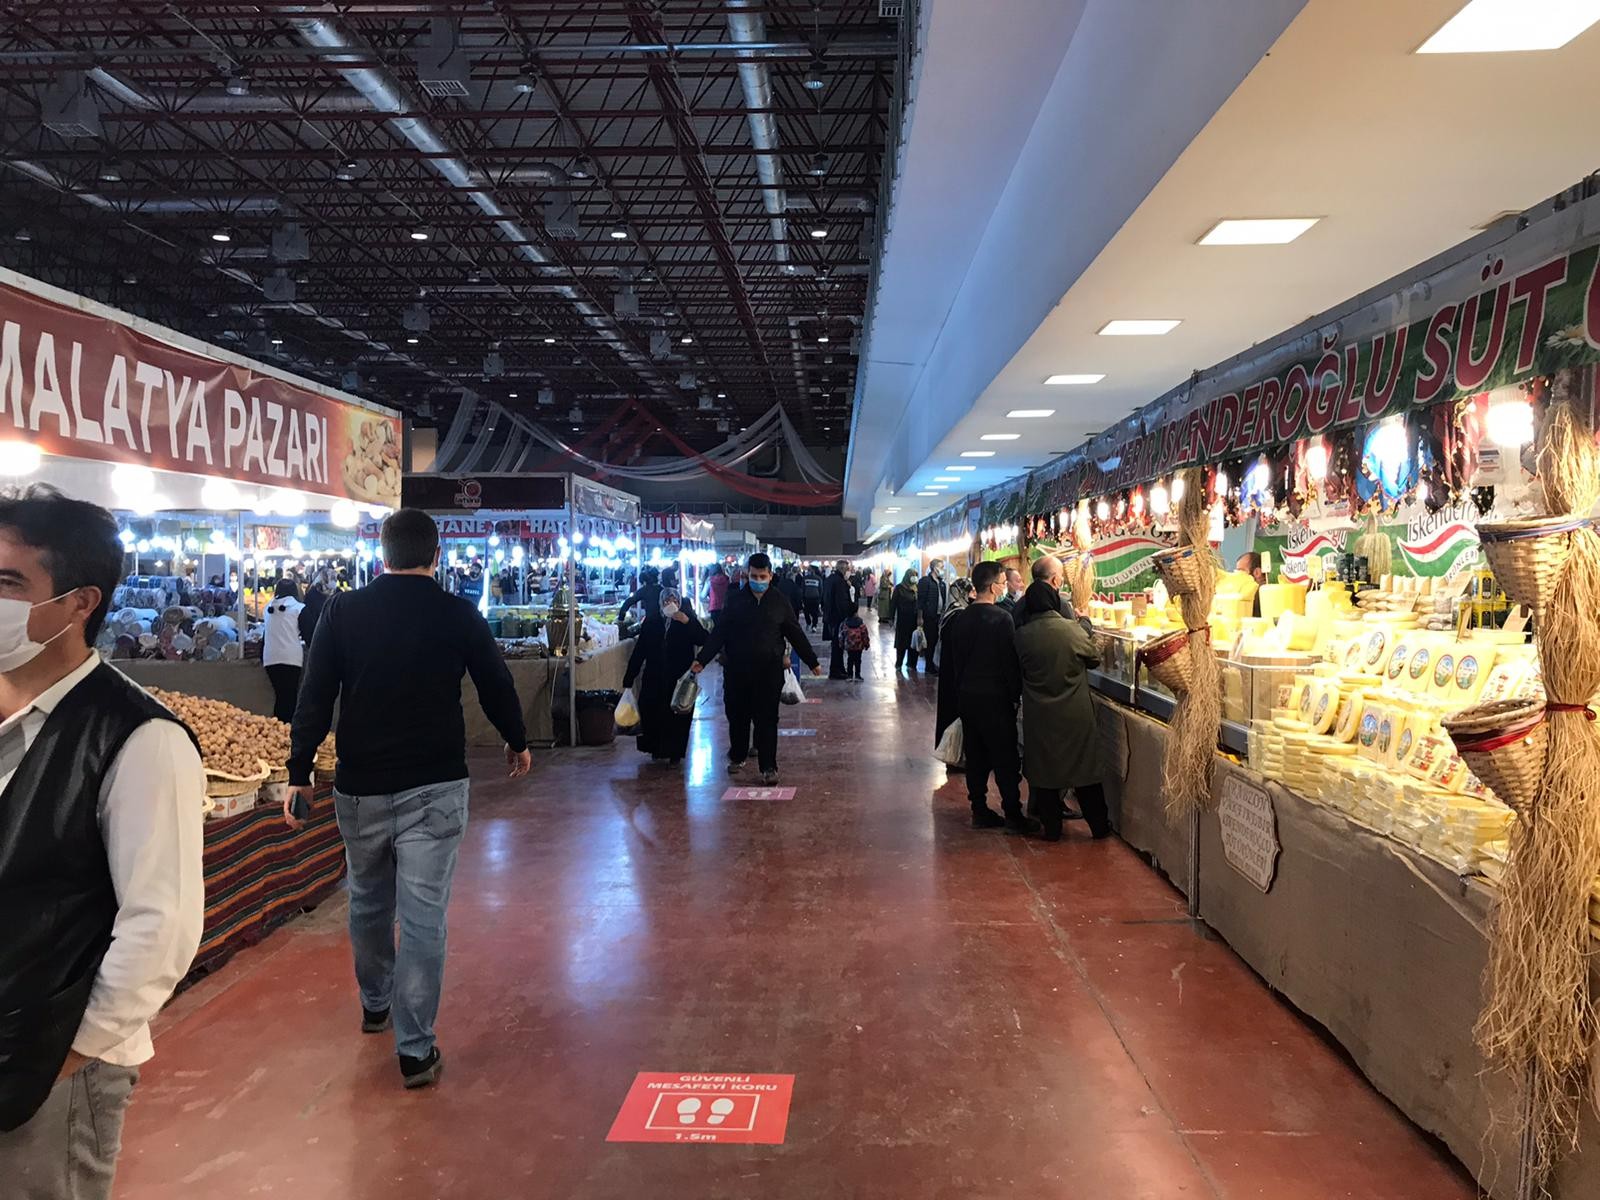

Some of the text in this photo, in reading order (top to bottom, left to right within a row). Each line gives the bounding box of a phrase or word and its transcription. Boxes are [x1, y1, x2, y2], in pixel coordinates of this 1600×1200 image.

[1156, 323, 1410, 473] İSKENDEROĞLU
[1413, 252, 1569, 404] SÜT
[0, 320, 328, 485] MALATYA PAZARI
[679, 1074, 750, 1083] GÜVENLİ
[646, 1082, 778, 1091] MESAFEYİ KORU
[674, 1132, 717, 1141] 1.5m
